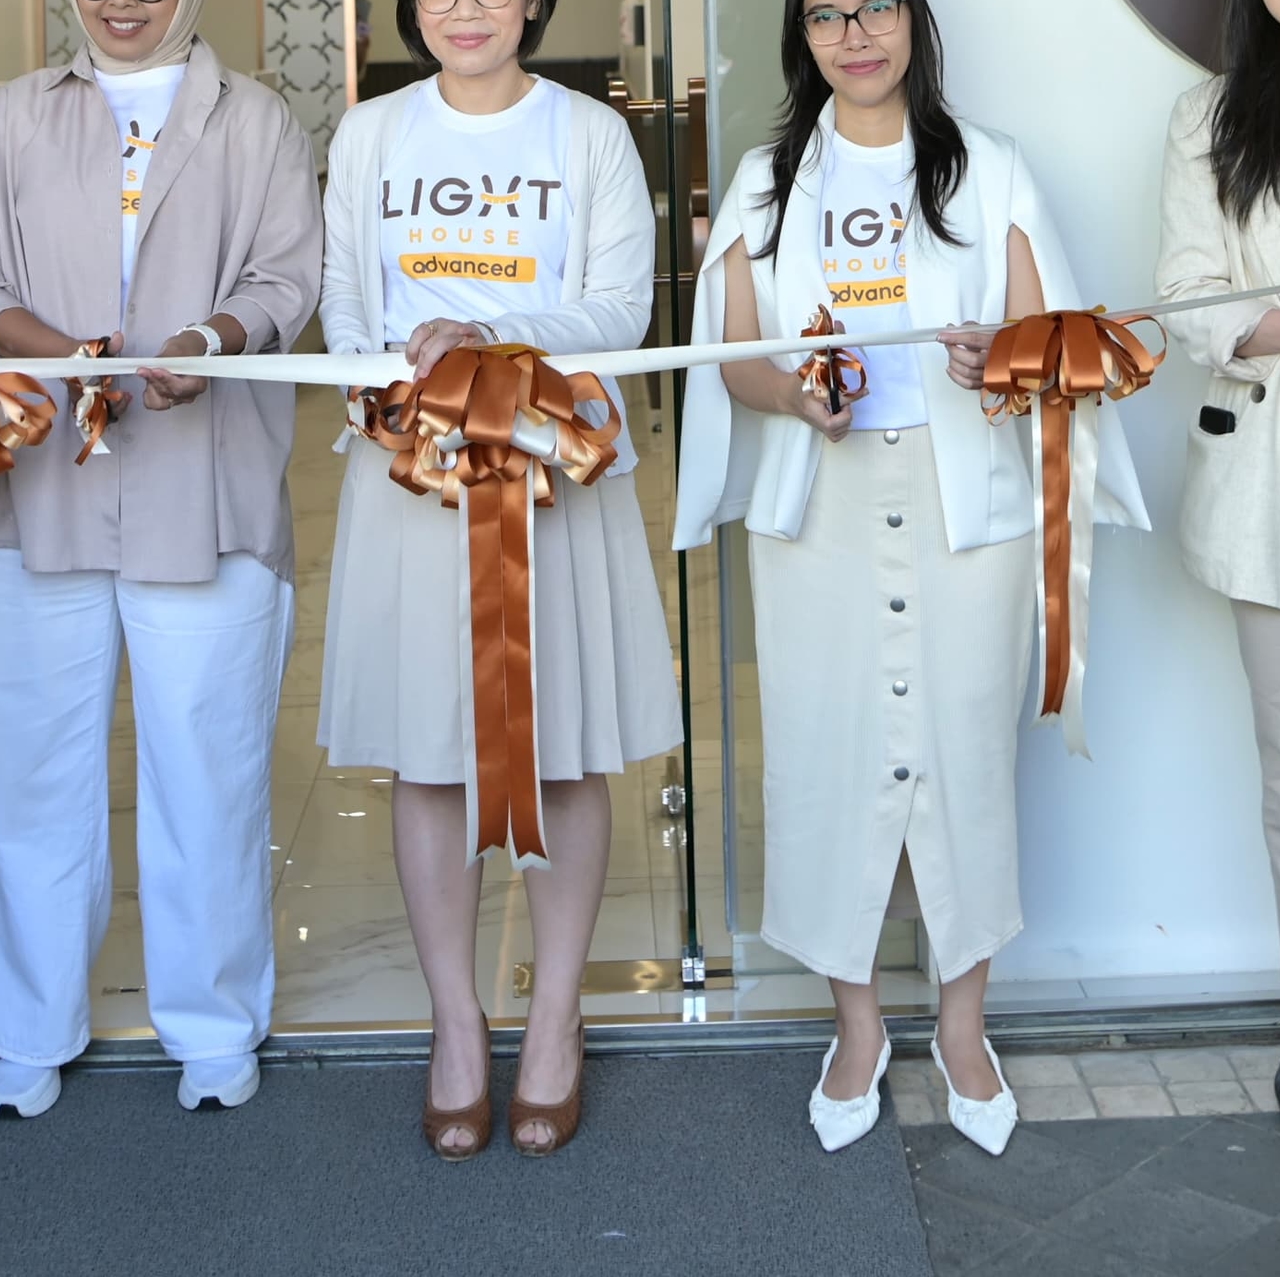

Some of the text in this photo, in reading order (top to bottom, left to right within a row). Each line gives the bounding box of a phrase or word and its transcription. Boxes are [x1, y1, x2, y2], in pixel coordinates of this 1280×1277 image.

[382, 175, 562, 220] LIGHT
[409, 227, 520, 245] HOUSE
[412, 256, 517, 277] advanced
[823, 254, 906, 273] HOUS
[830, 284, 904, 303] advanc
